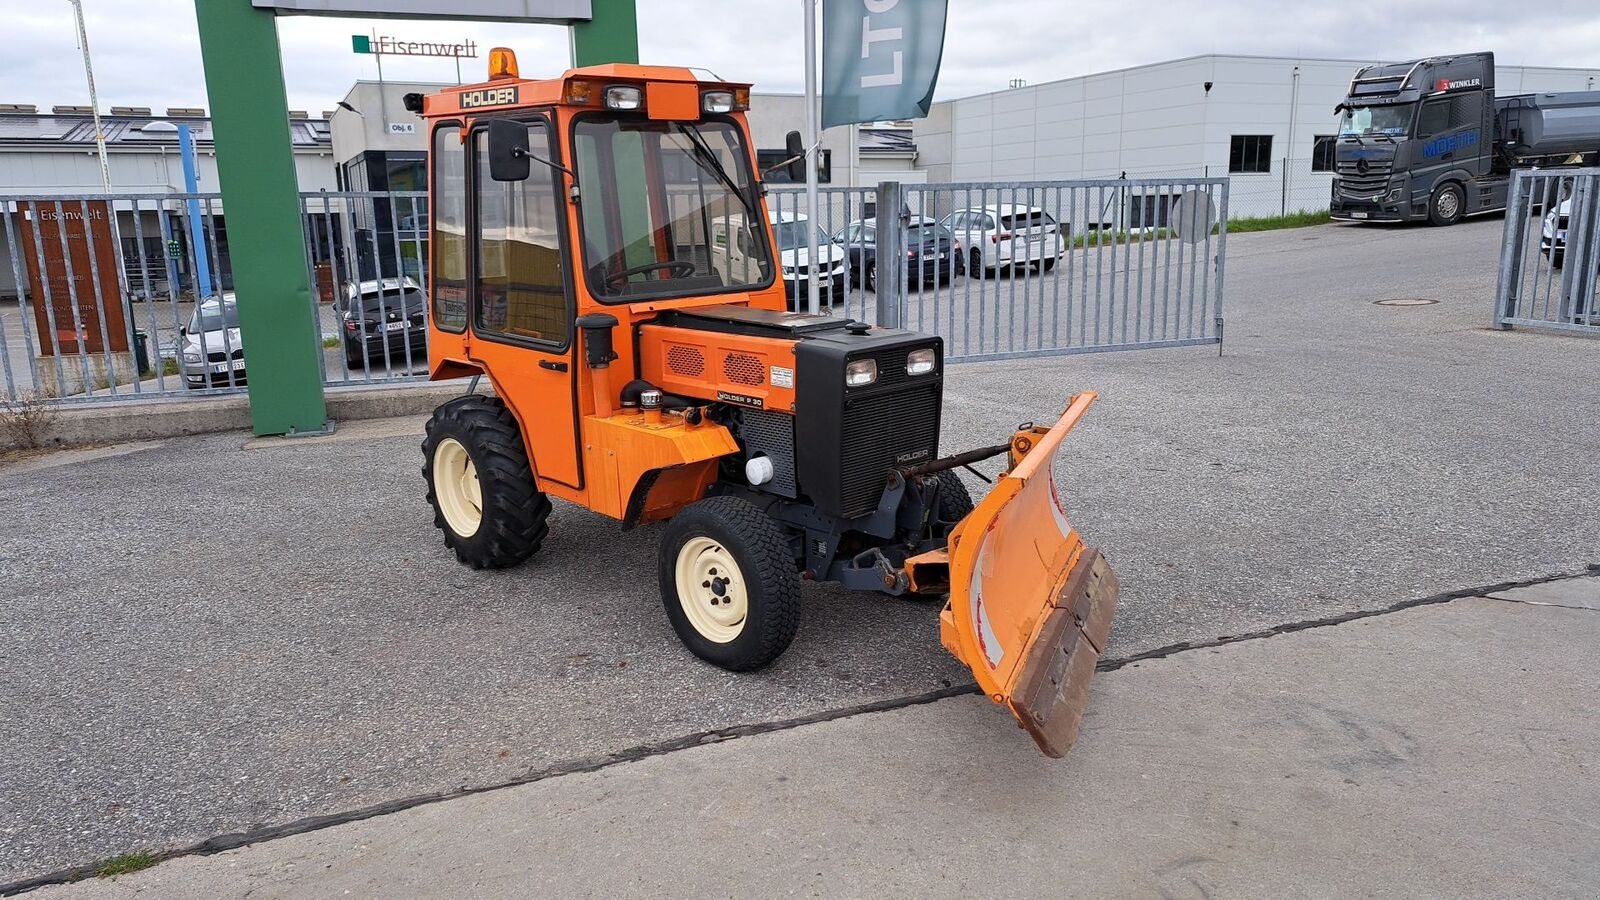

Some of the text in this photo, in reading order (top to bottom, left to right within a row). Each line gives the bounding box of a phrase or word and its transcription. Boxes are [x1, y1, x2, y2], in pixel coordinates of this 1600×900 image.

[380, 36, 477, 57] Eisenwelt
[1449, 78, 1481, 89] WINKLER
[462, 87, 515, 108] HOLDER
[391, 124, 413, 132] Obj. 6
[718, 391, 745, 403] HOLDER
[752, 398, 763, 406] 30
[896, 449, 929, 463] HOLDER
